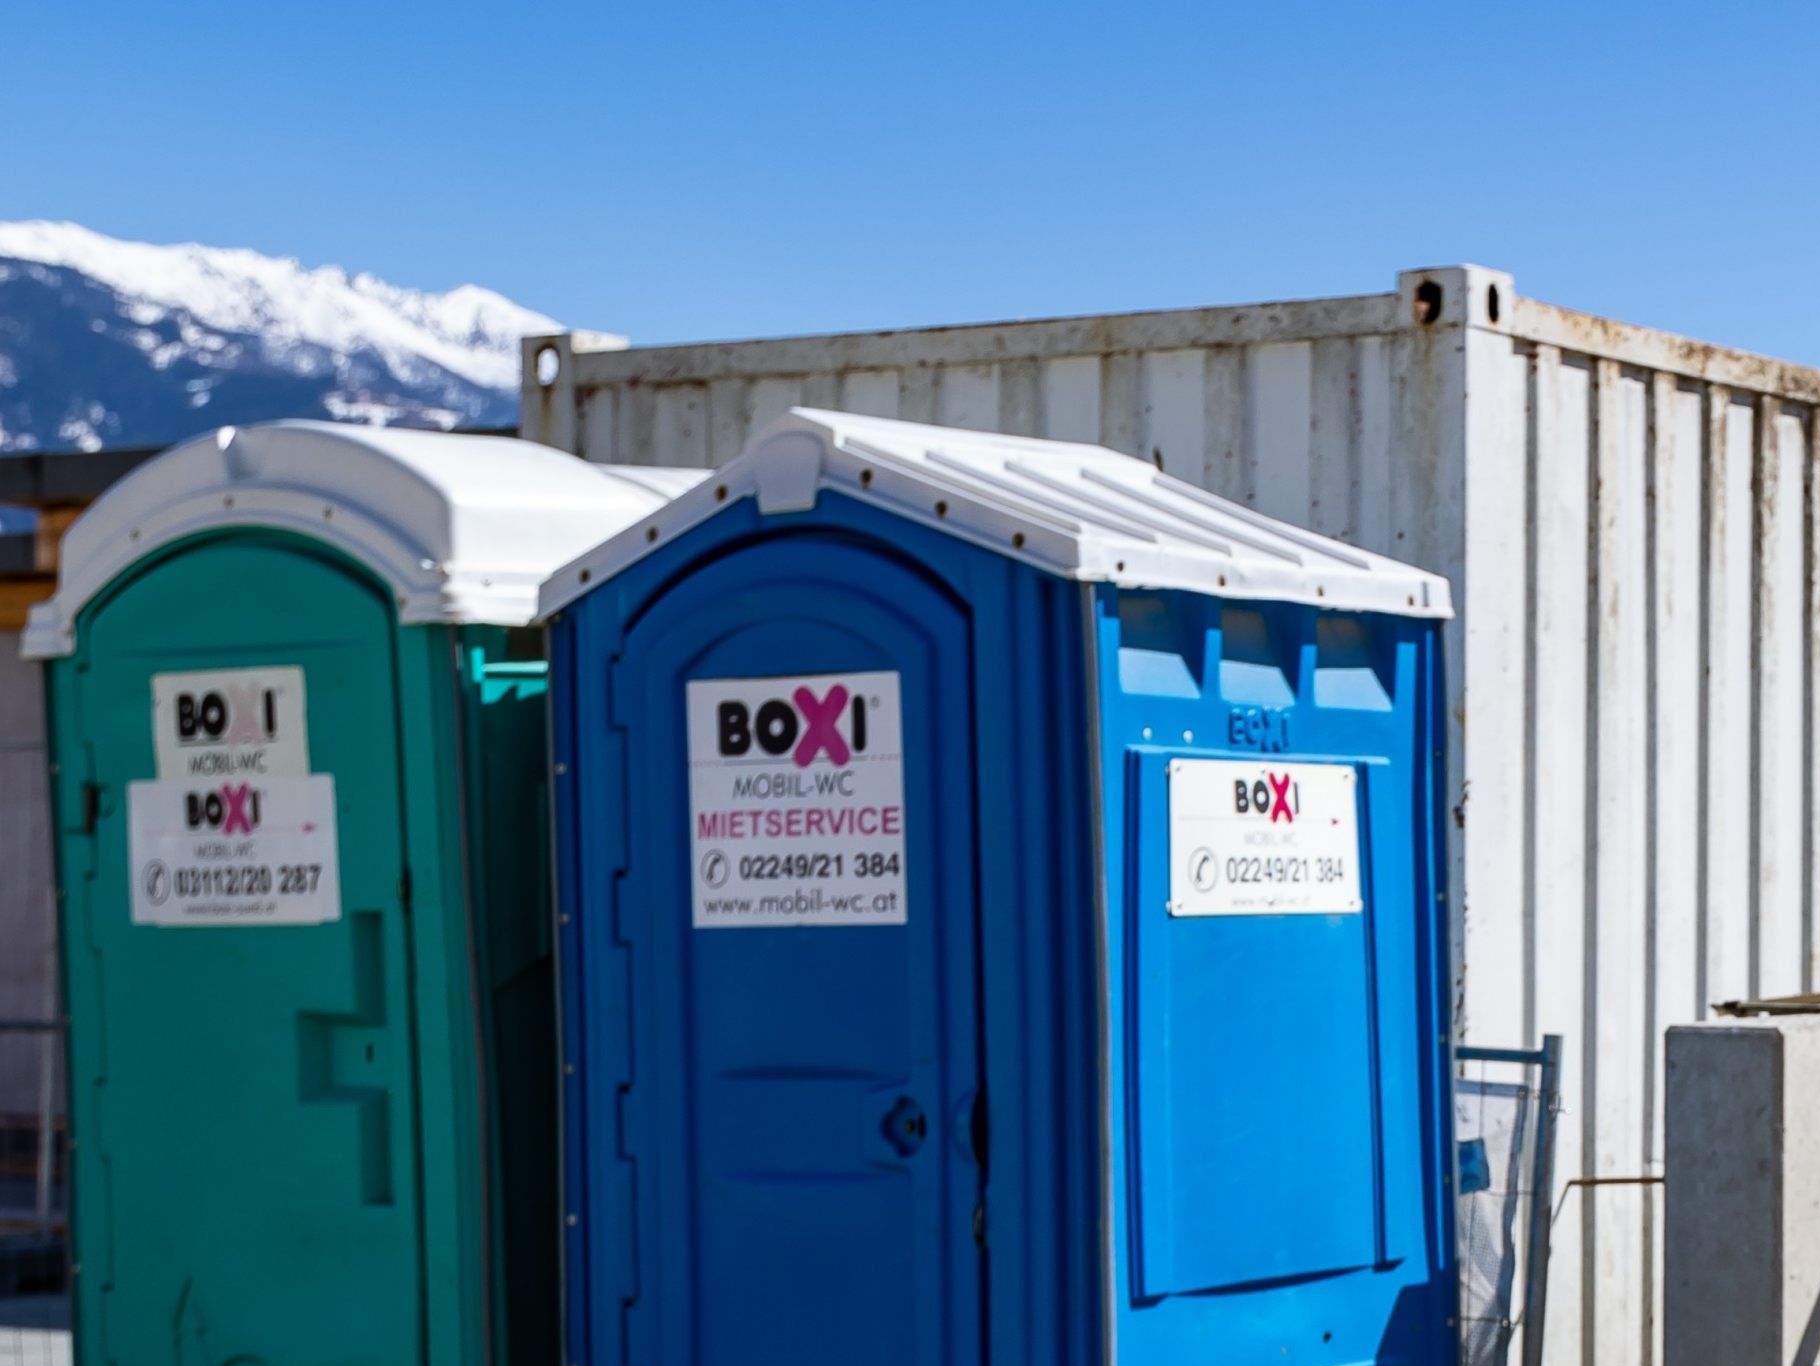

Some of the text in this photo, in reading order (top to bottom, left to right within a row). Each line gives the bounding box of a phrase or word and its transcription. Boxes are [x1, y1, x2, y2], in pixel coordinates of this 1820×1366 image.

[717, 683, 867, 769] BOXI
[732, 770, 856, 800] MOBIL-WC
[1234, 772, 1300, 824] BOXI
[185, 783, 260, 836] BOXI
[698, 806, 902, 841] MIETSERVICE
[739, 852, 900, 881] 02249/21 384
[1226, 857, 1344, 884] 02249/21 384
[704, 888, 898, 915] www.mobil-wc.at
